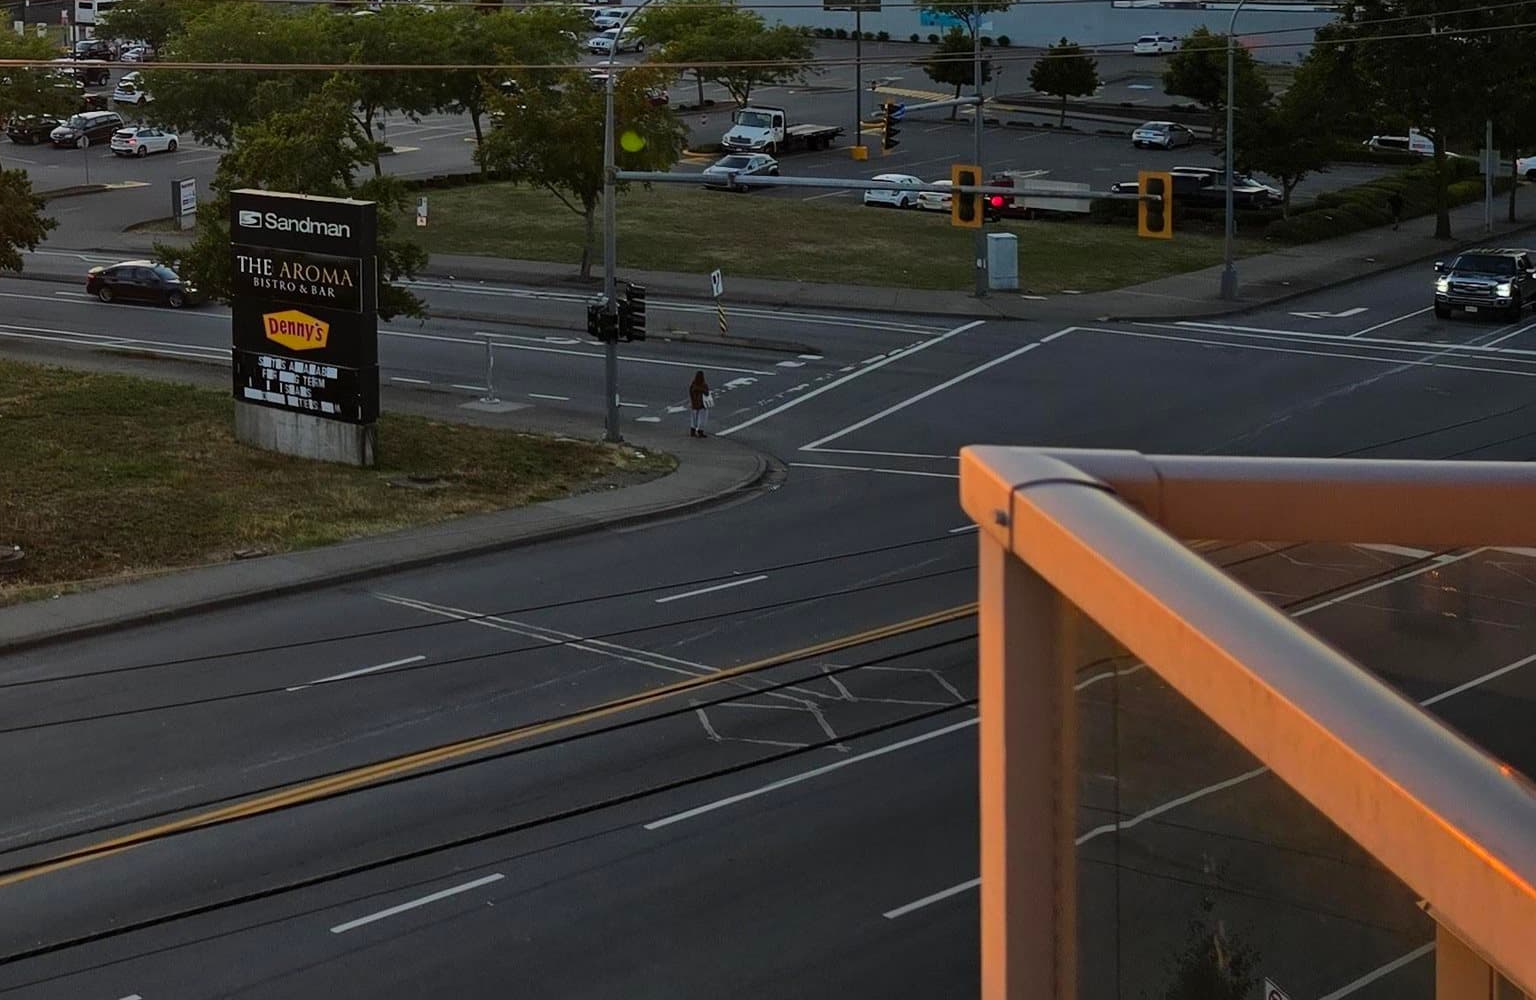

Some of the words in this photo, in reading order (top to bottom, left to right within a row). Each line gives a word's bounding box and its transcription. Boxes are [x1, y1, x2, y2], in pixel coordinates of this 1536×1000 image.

[264, 212, 351, 238] Sandman
[237, 255, 273, 276] THE
[280, 261, 353, 288] AROMA
[253, 277, 296, 292] BISTRO
[299, 284, 308, 294] &
[311, 285, 336, 298] BAR
[268, 318, 324, 342] Denny's
